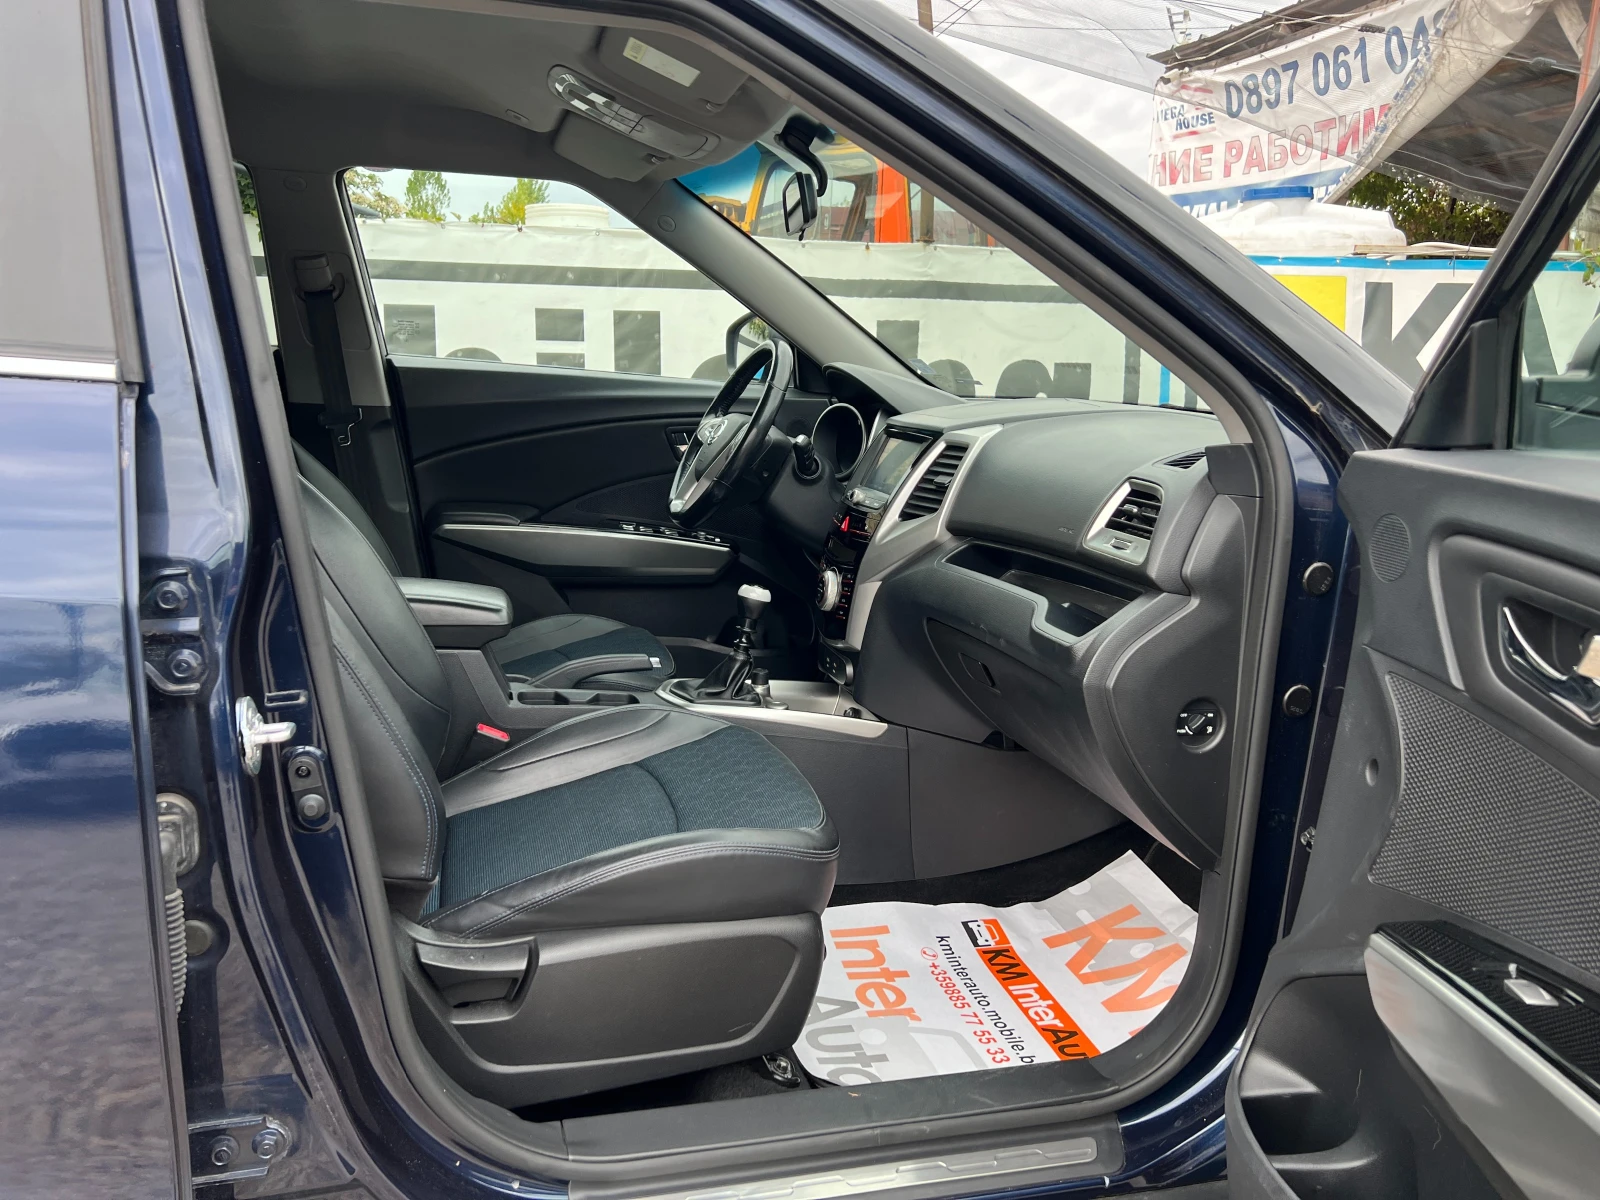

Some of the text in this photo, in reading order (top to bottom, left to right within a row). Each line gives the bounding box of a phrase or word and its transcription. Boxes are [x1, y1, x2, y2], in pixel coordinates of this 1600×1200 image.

[1225, 60, 1299, 118] 0897
[1312, 36, 1370, 96] 061
[1176, 112, 1215, 131] HOUSE
[1150, 144, 1214, 187] НИЕ
[829, 925, 922, 1022] Inter
[936, 936, 1036, 1064] kminterauto.mobile.b
[982, 948, 1029, 982] KM
[929, 962, 1011, 1064] +359885 77 55 33
